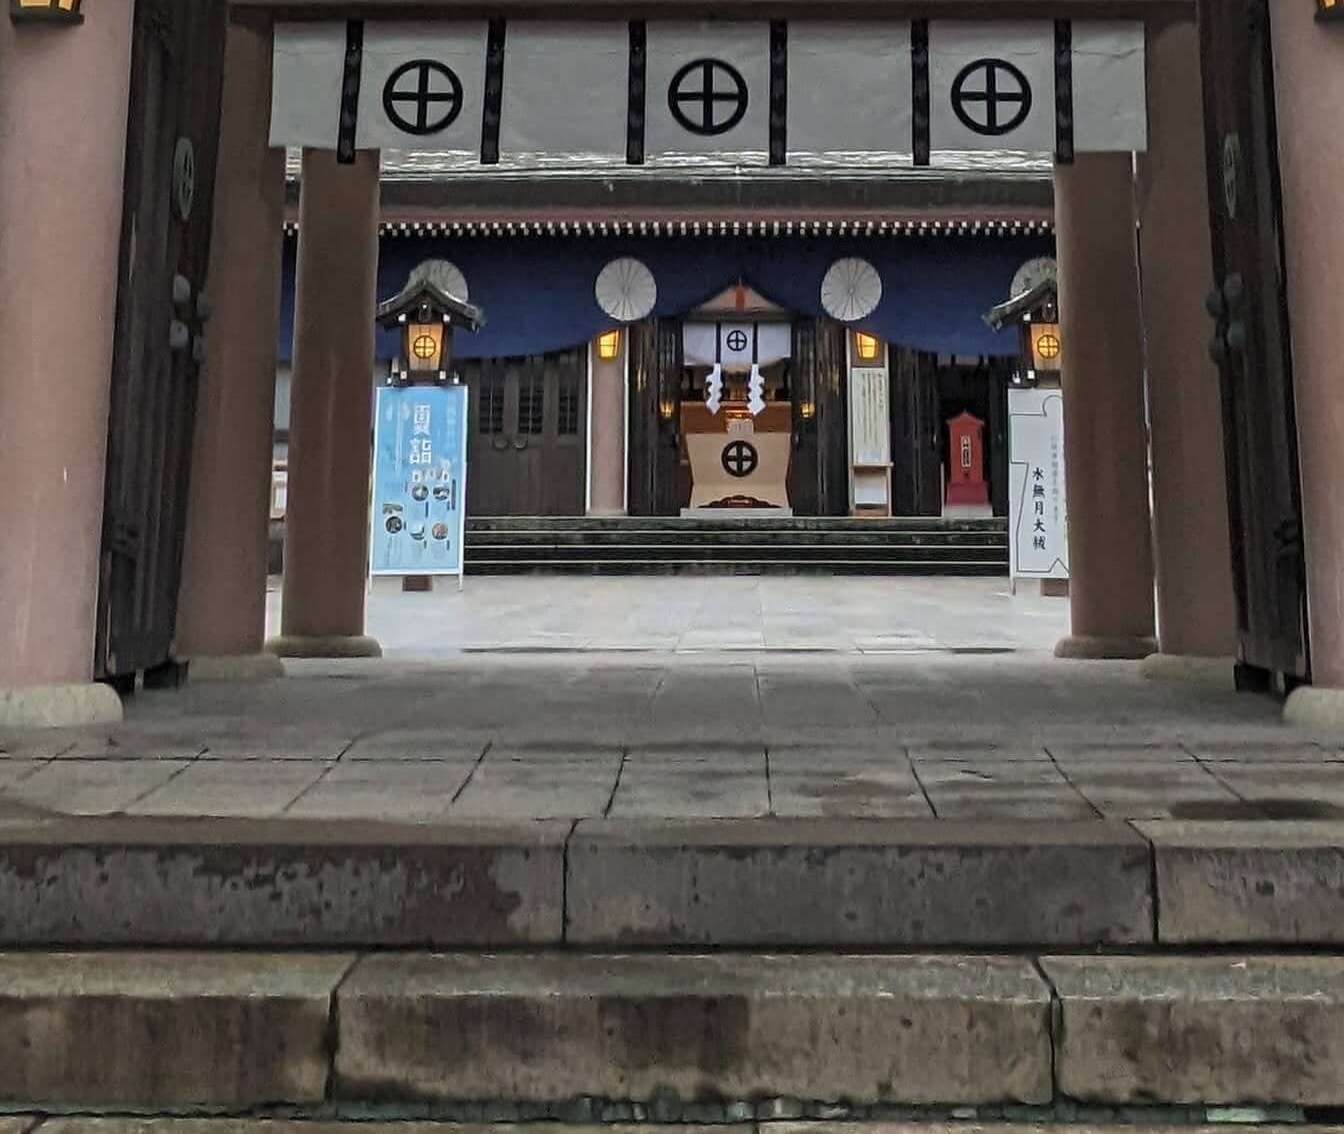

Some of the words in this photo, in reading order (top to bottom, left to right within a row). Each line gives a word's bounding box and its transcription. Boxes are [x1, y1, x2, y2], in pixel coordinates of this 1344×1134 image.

[1031, 467, 1047, 550] 水無月大祓
